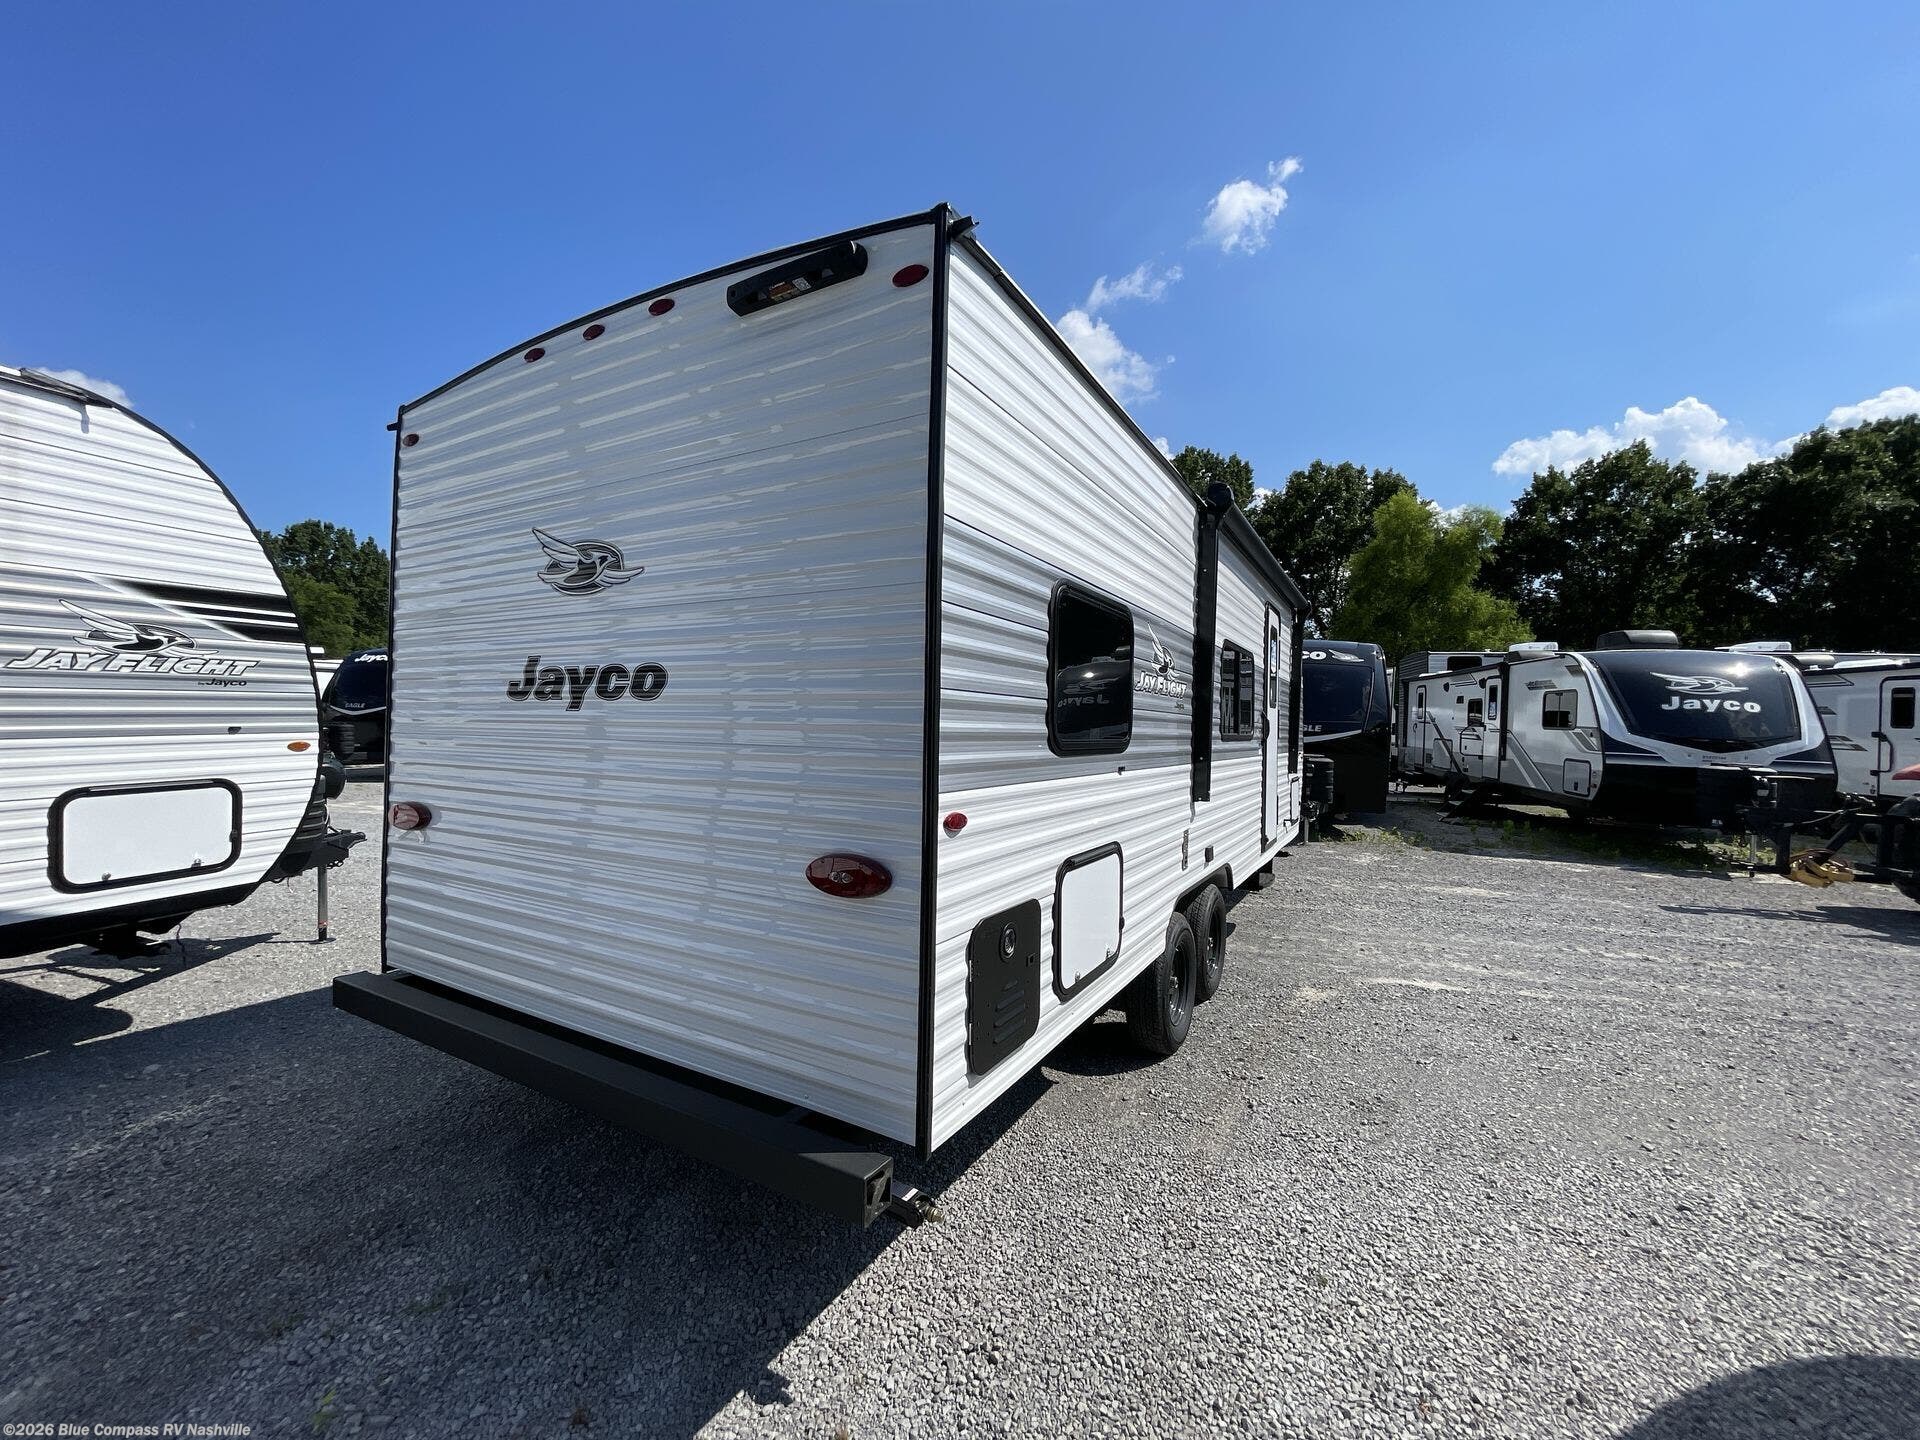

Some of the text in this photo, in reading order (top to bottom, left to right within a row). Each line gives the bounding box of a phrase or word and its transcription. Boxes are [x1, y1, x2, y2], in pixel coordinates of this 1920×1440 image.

[3, 648, 260, 676] JAY FLIGHT
[205, 677, 247, 688] Jayco
[506, 655, 669, 711] Jayco
[1134, 670, 1187, 699] JAY FLIGHT
[1661, 696, 1761, 713] Jayco
